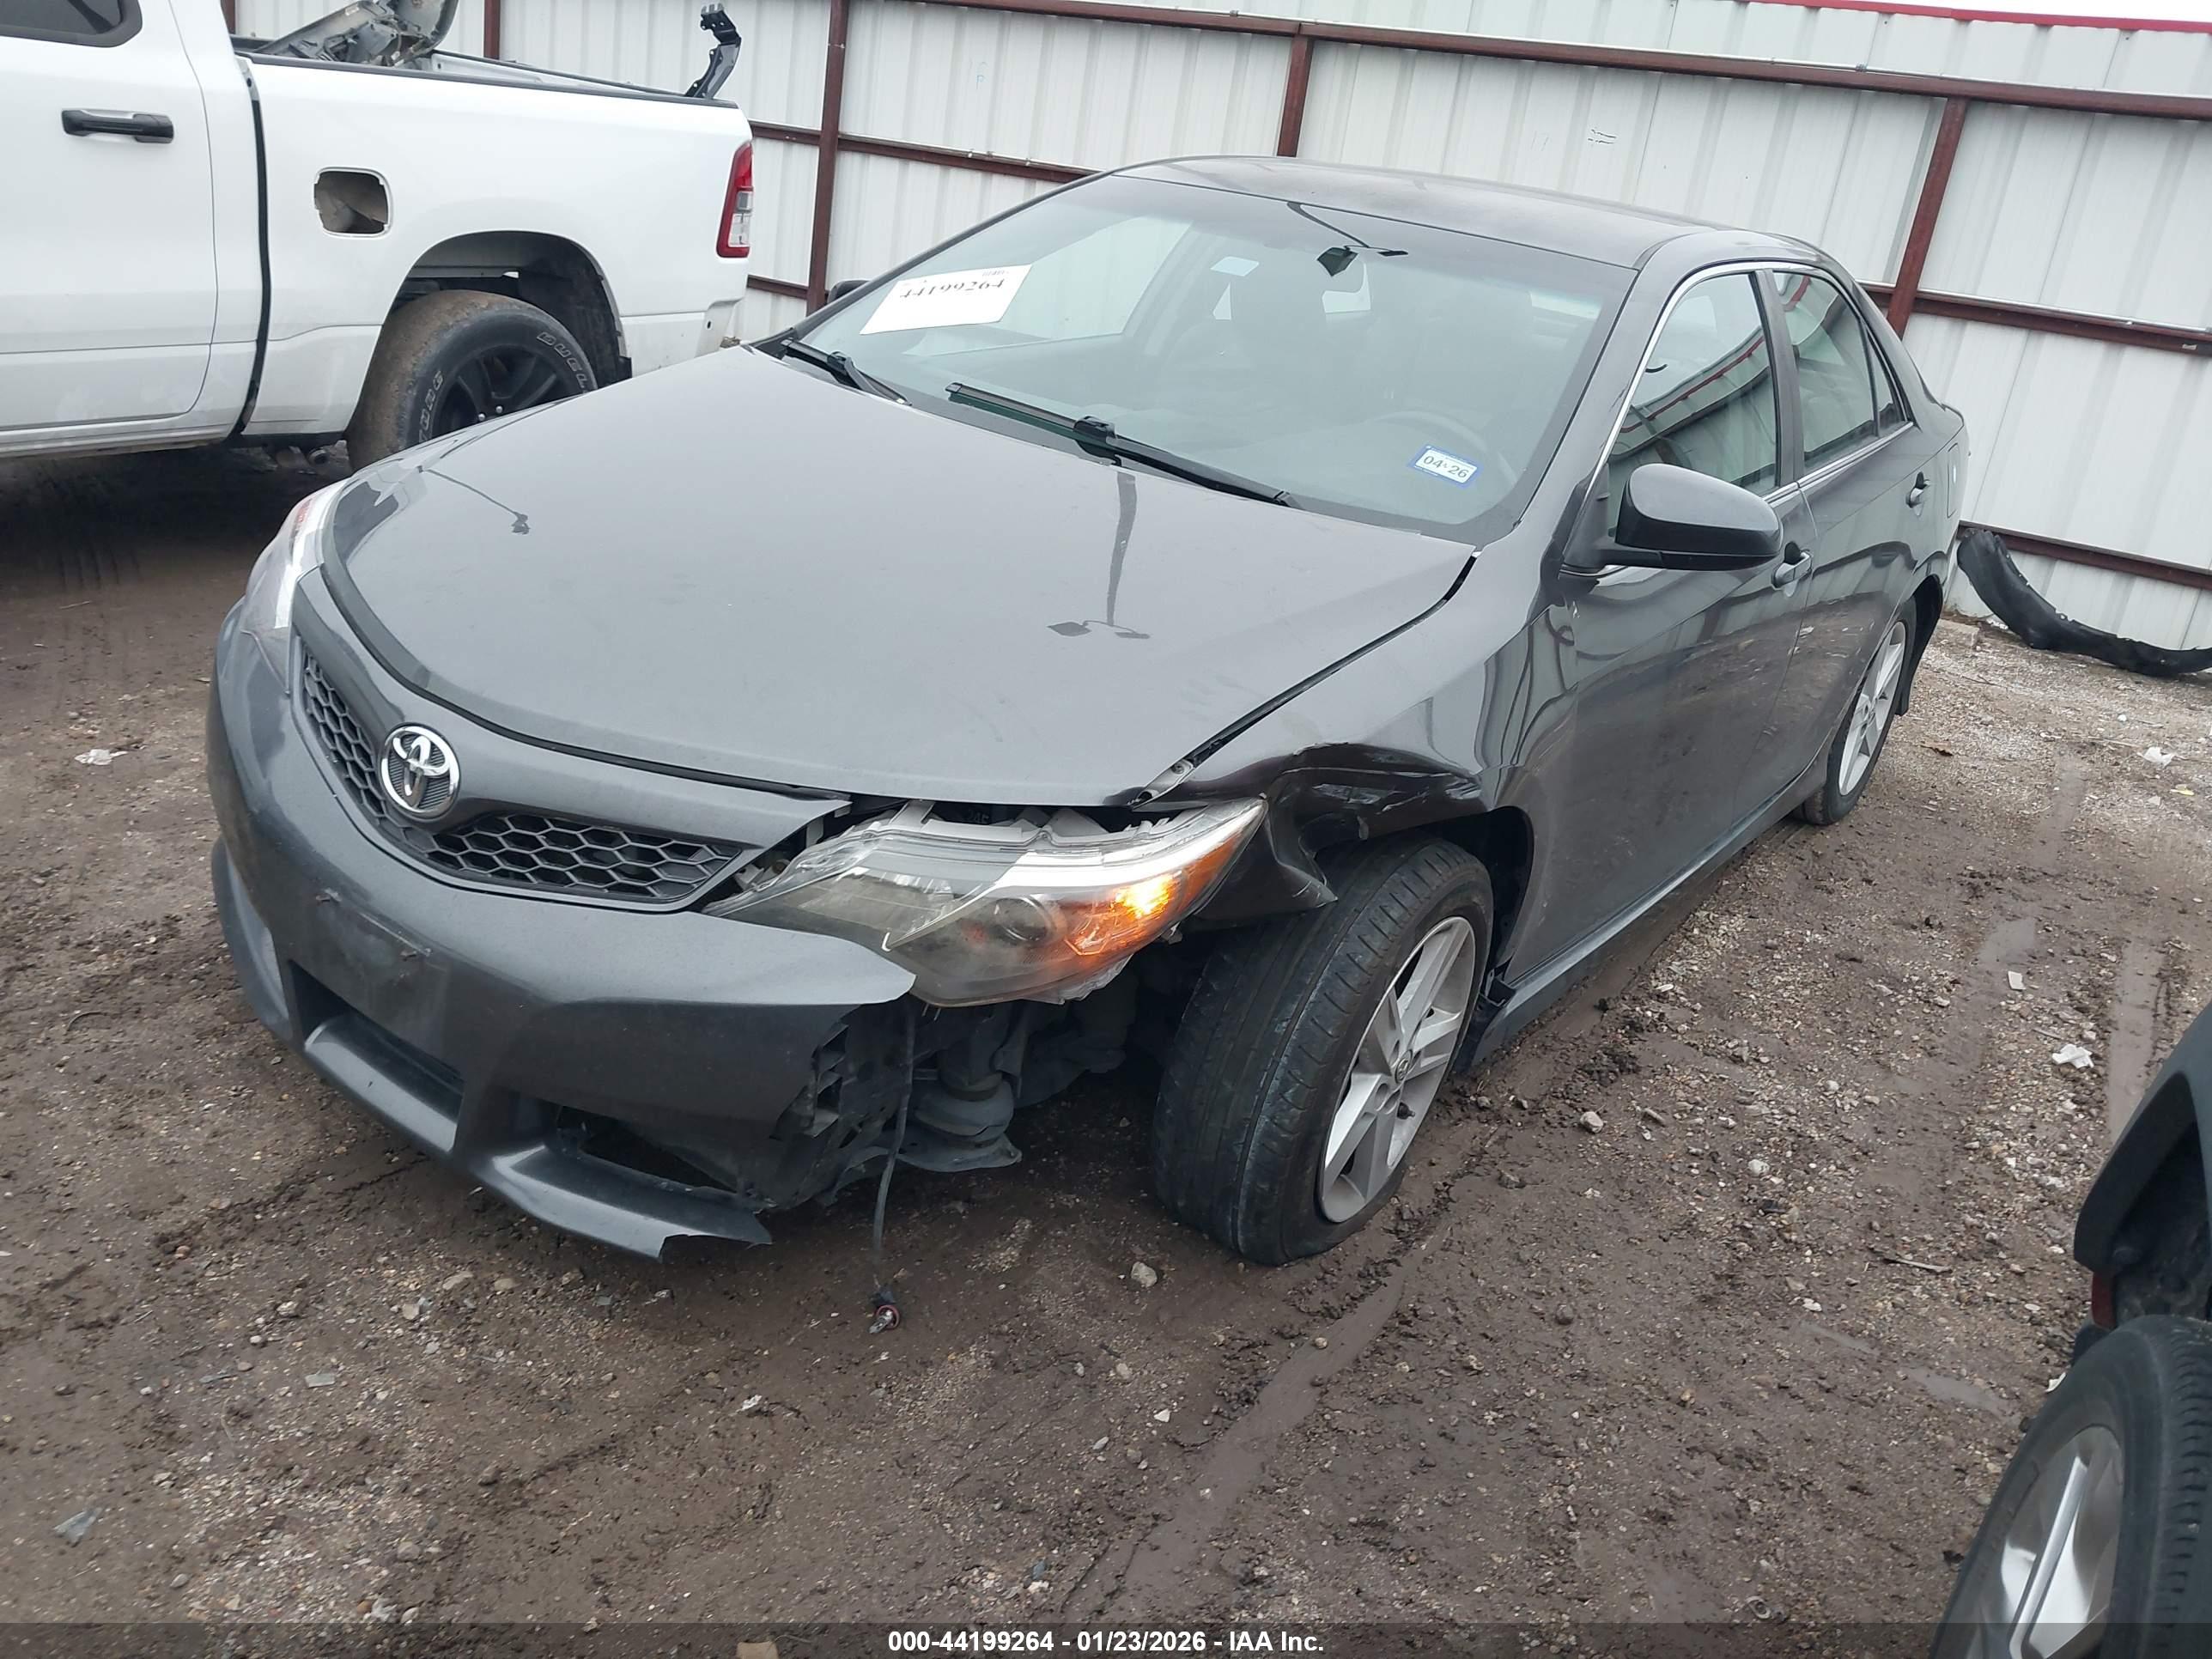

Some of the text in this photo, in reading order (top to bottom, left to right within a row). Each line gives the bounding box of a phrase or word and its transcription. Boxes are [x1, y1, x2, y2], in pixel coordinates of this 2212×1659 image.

[899, 278, 1005, 298] 44199264
[1423, 455, 1443, 469] 04
[1447, 465, 1469, 478] 26
